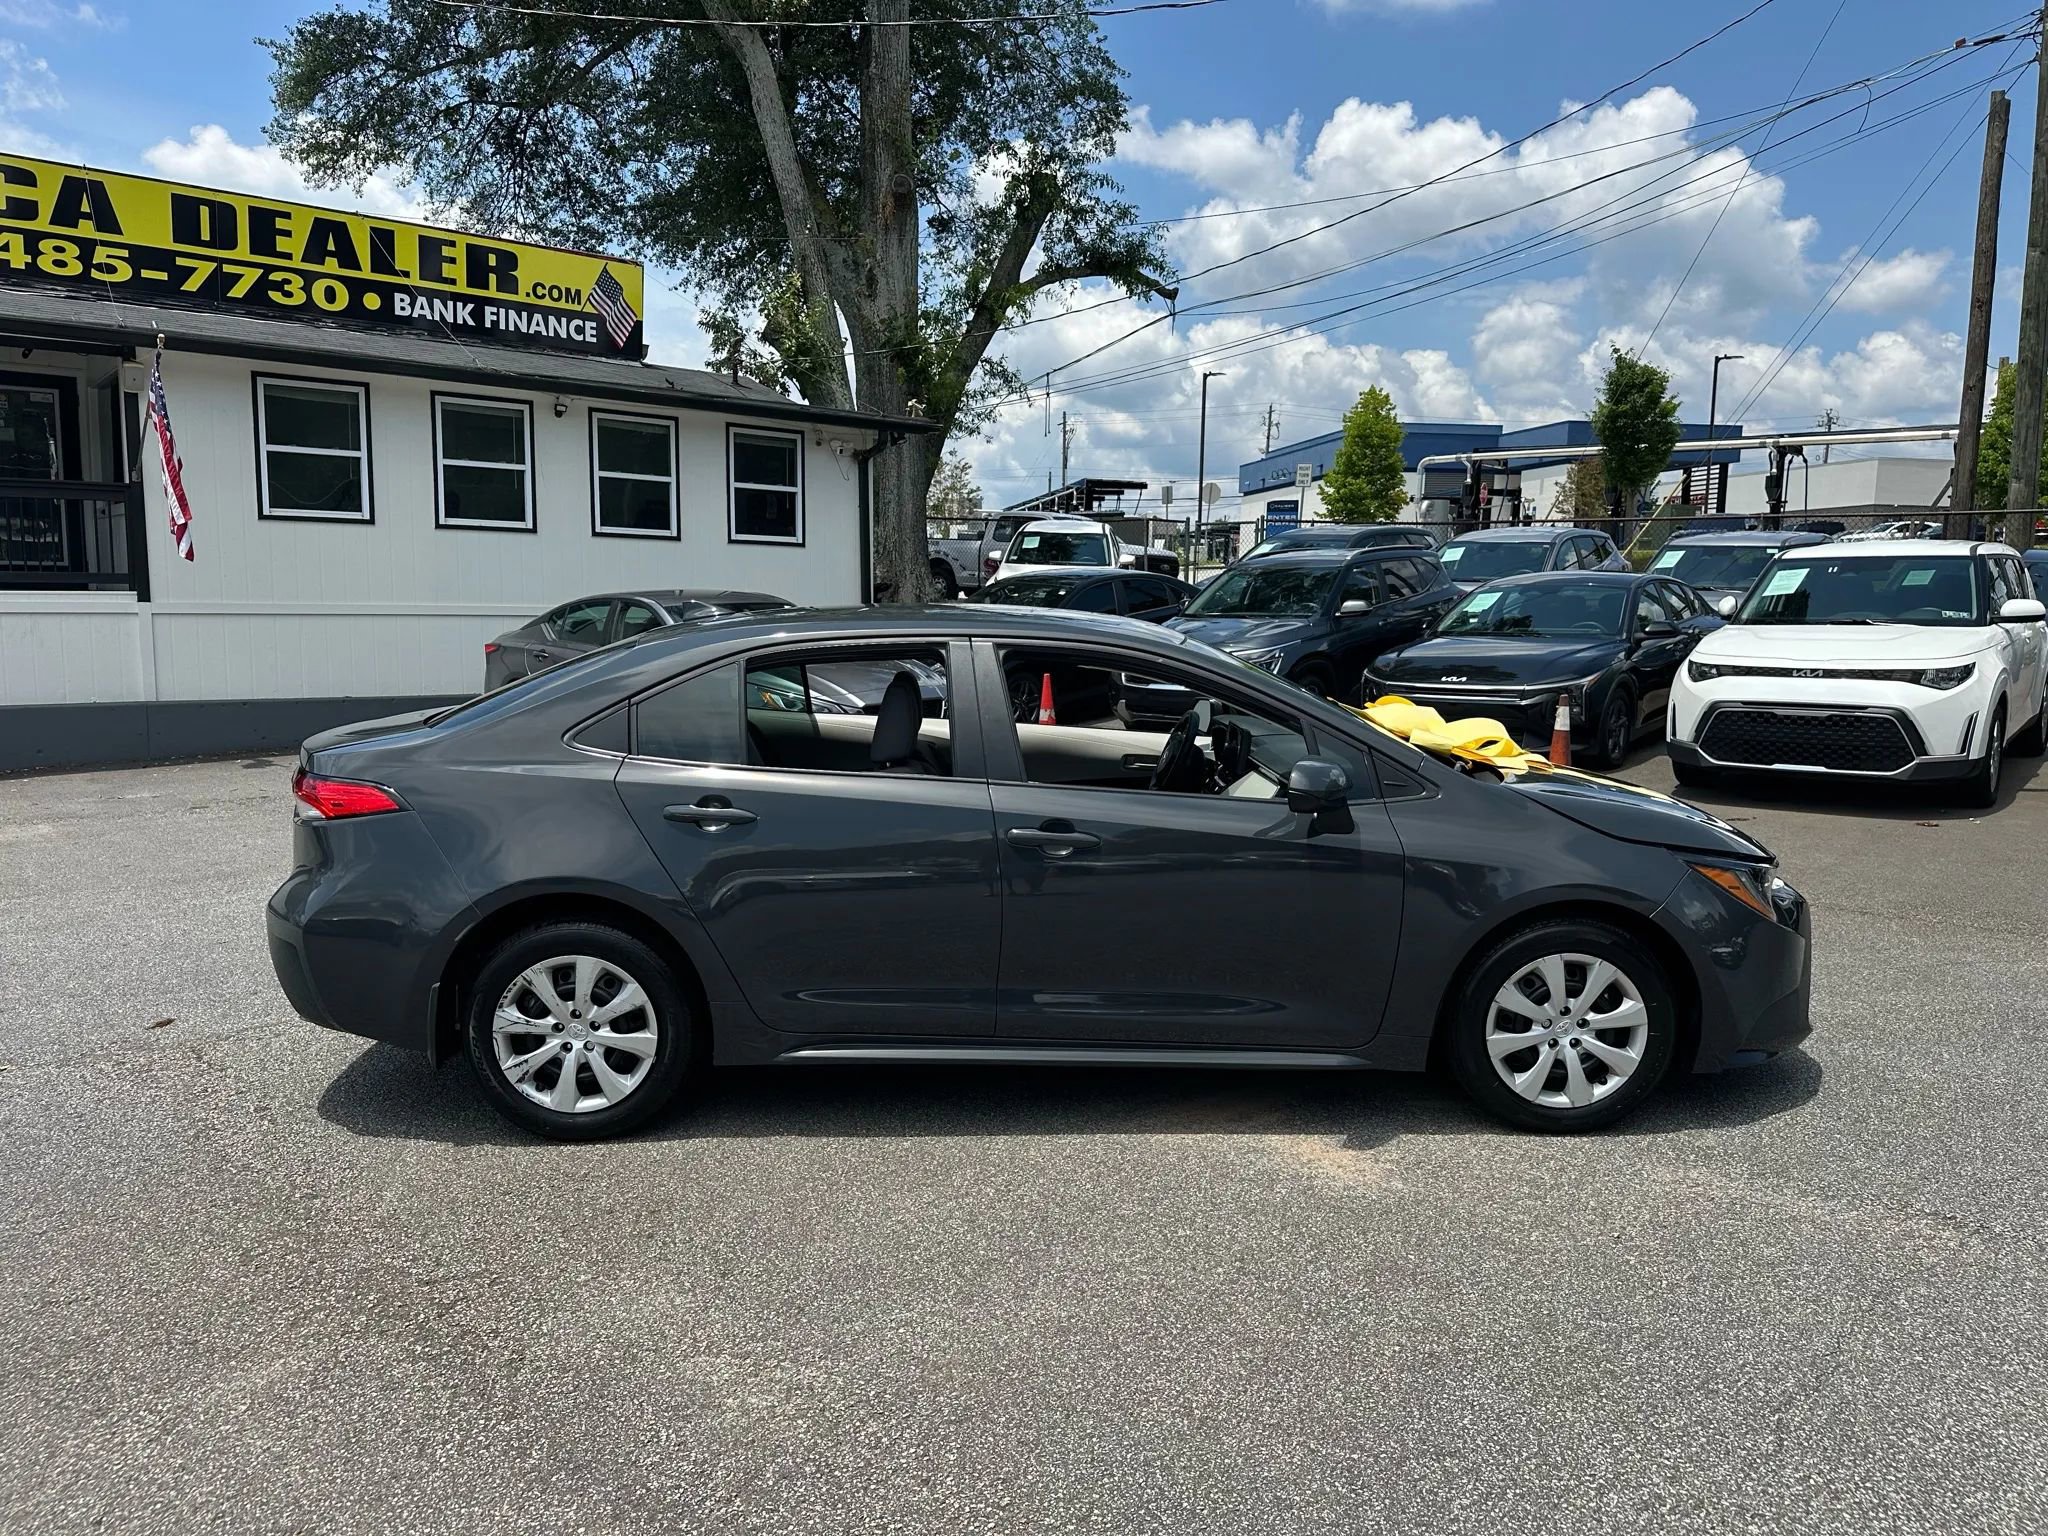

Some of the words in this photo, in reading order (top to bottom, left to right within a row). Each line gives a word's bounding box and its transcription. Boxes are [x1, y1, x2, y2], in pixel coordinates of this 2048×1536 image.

[0, 231, 349, 312] 485-7730
[393, 292, 476, 326] BANK
[484, 305, 598, 343] FINANCE
